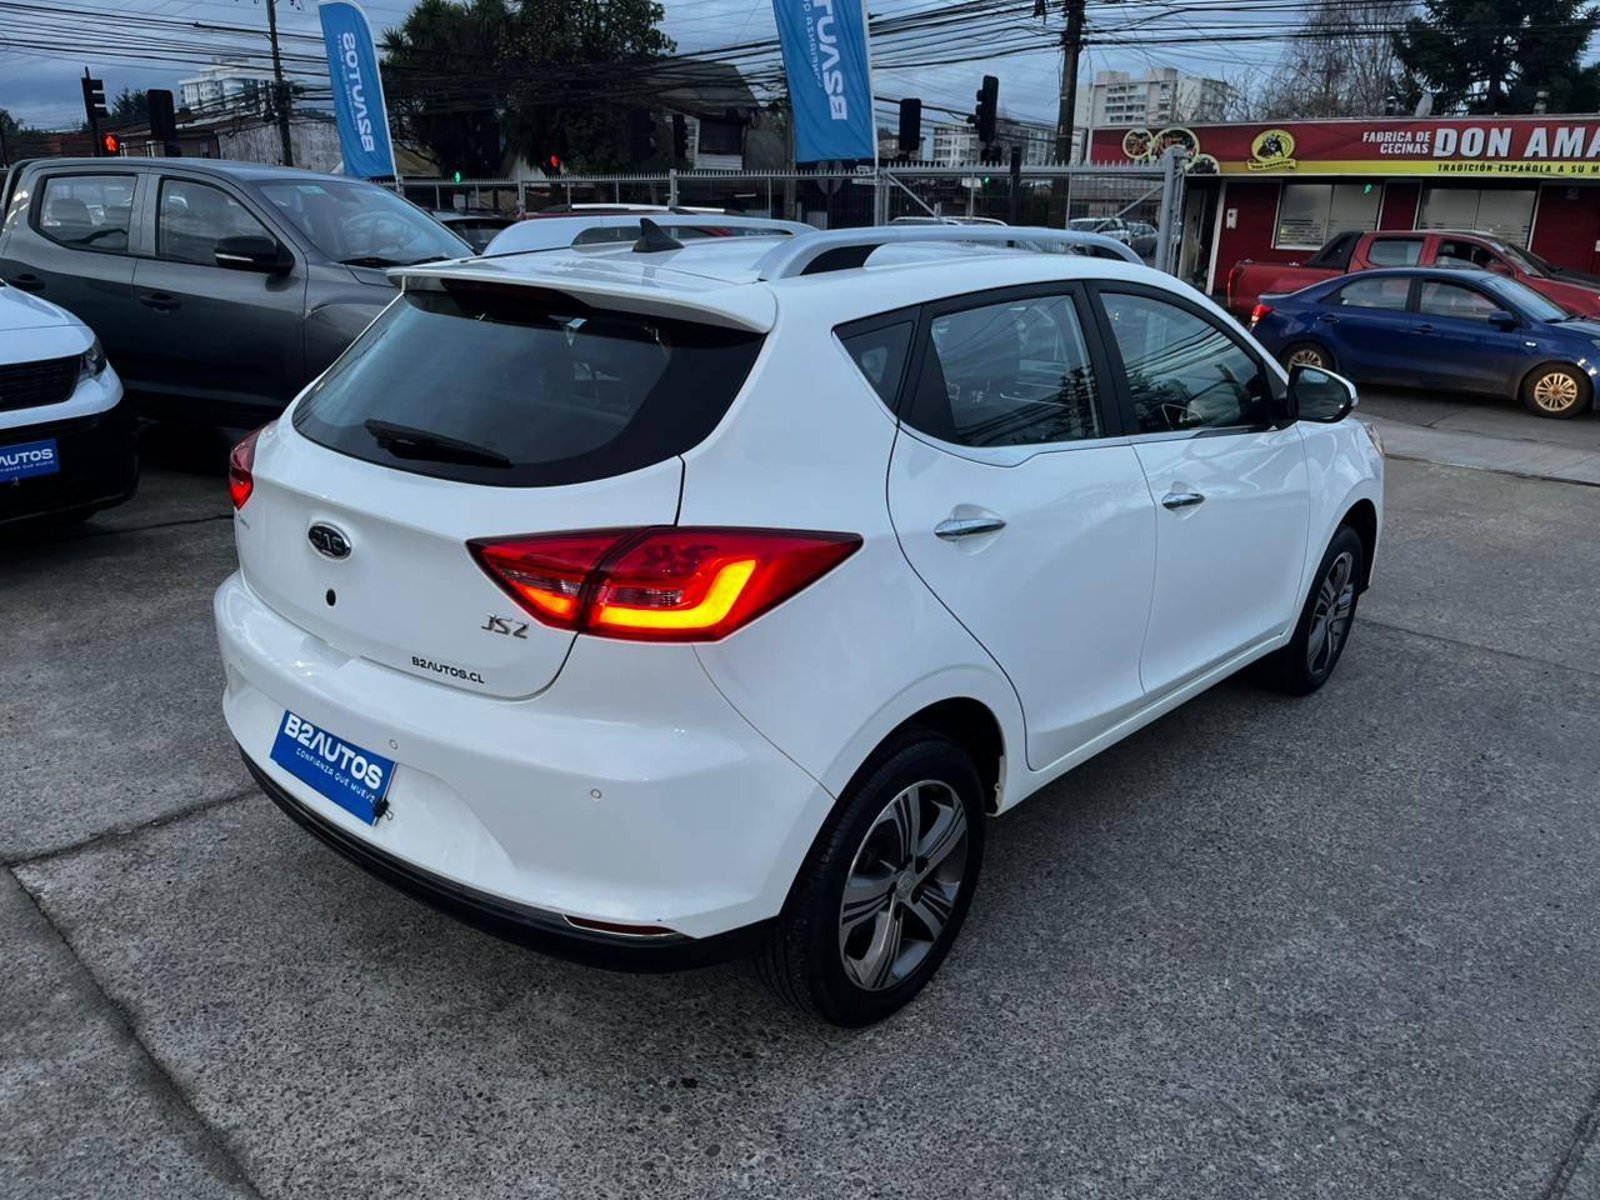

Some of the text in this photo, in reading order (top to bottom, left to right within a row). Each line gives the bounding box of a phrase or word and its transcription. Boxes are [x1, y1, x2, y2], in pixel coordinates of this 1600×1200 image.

[1363, 131, 1431, 143] FABRICA DE
[1380, 143, 1429, 154] CECINAS
[1433, 127, 1512, 157] DON
[1558, 165, 1564, 173] A
[1571, 165, 1584, 173] SU
[411, 656, 485, 684] B2AUTOS.CL
[284, 713, 383, 790] B2AUTOS
[295, 748, 334, 776] CONFIANZA
[334, 773, 350, 786] QUE
